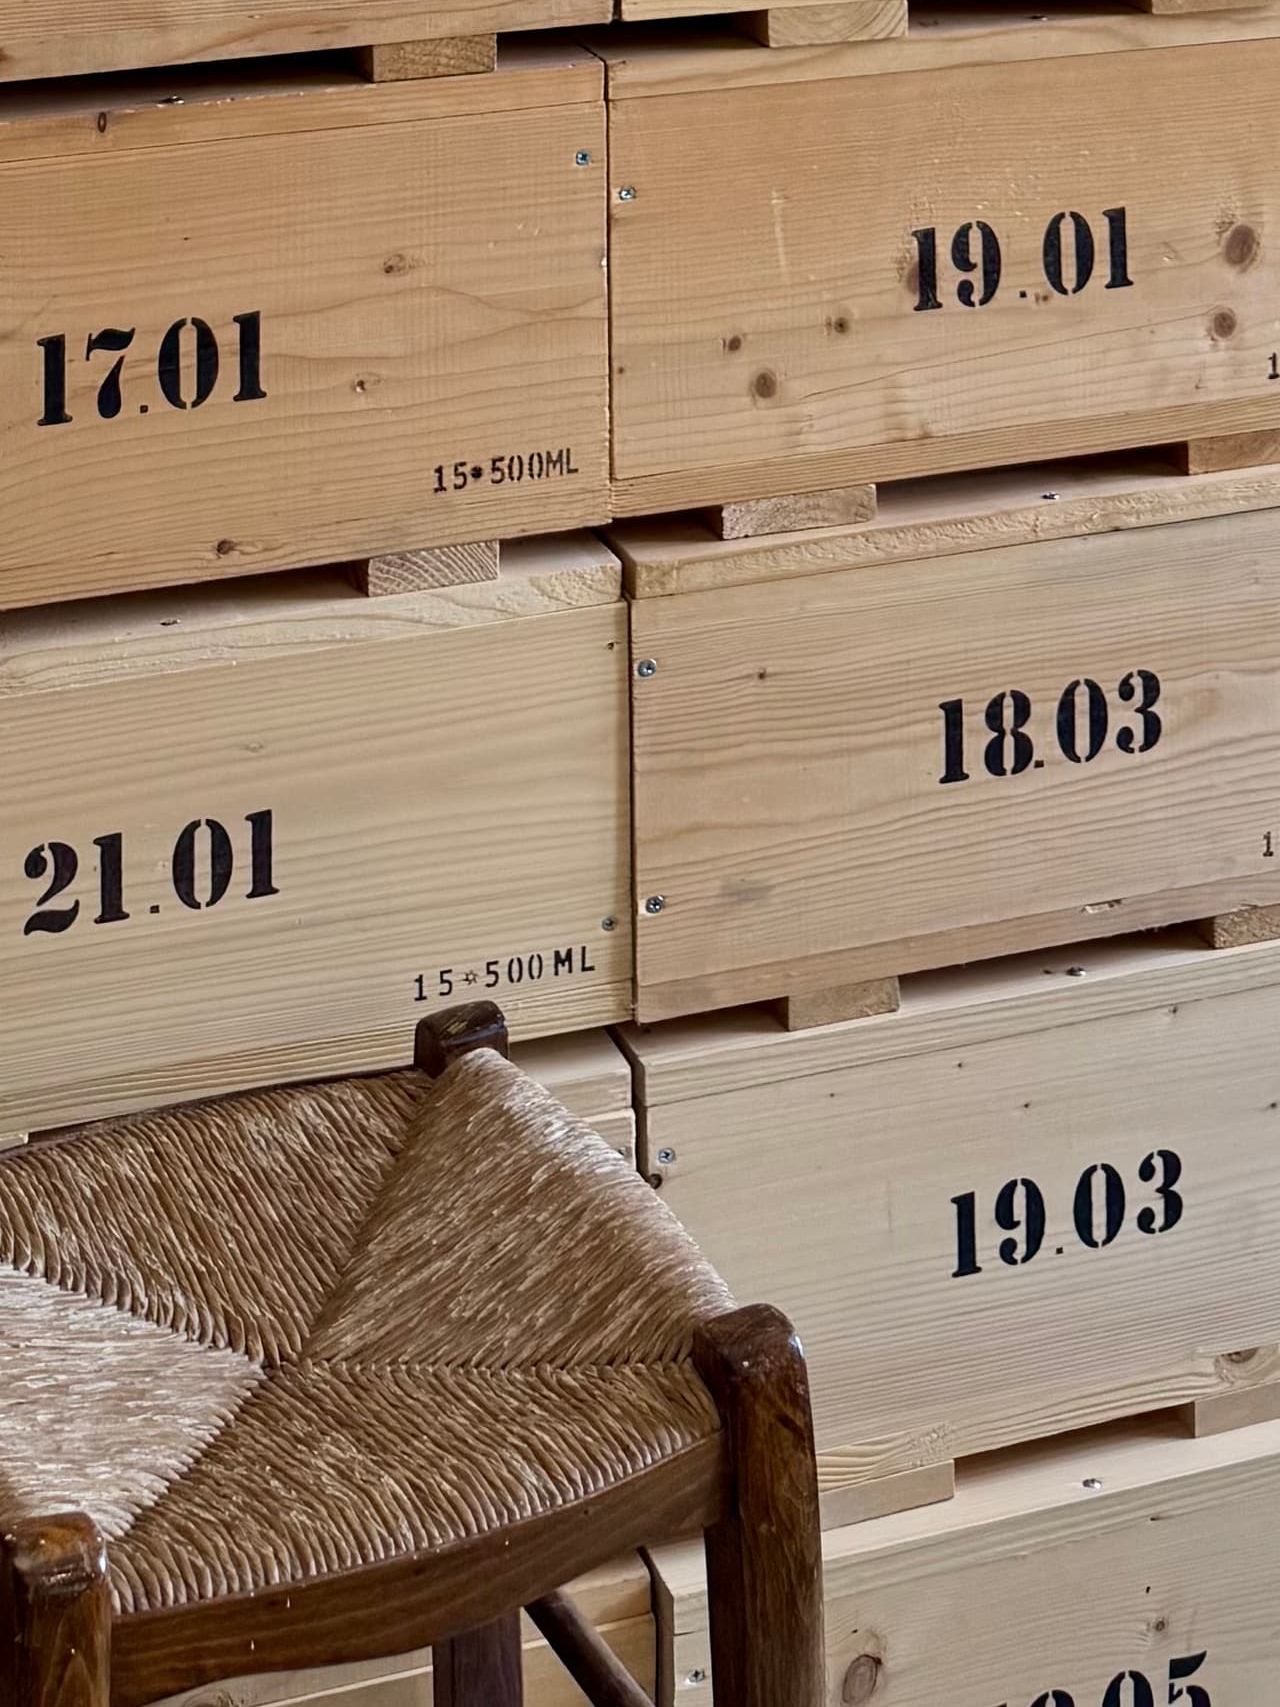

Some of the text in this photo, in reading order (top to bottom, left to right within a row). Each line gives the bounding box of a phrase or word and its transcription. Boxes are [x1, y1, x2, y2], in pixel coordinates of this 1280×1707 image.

[912, 206, 1134, 312] 19.01
[36, 310, 267, 427] 17.01
[938, 669, 1163, 785] 18.03
[23, 809, 280, 936] 21.01
[950, 1149, 1184, 1278] 19.03
